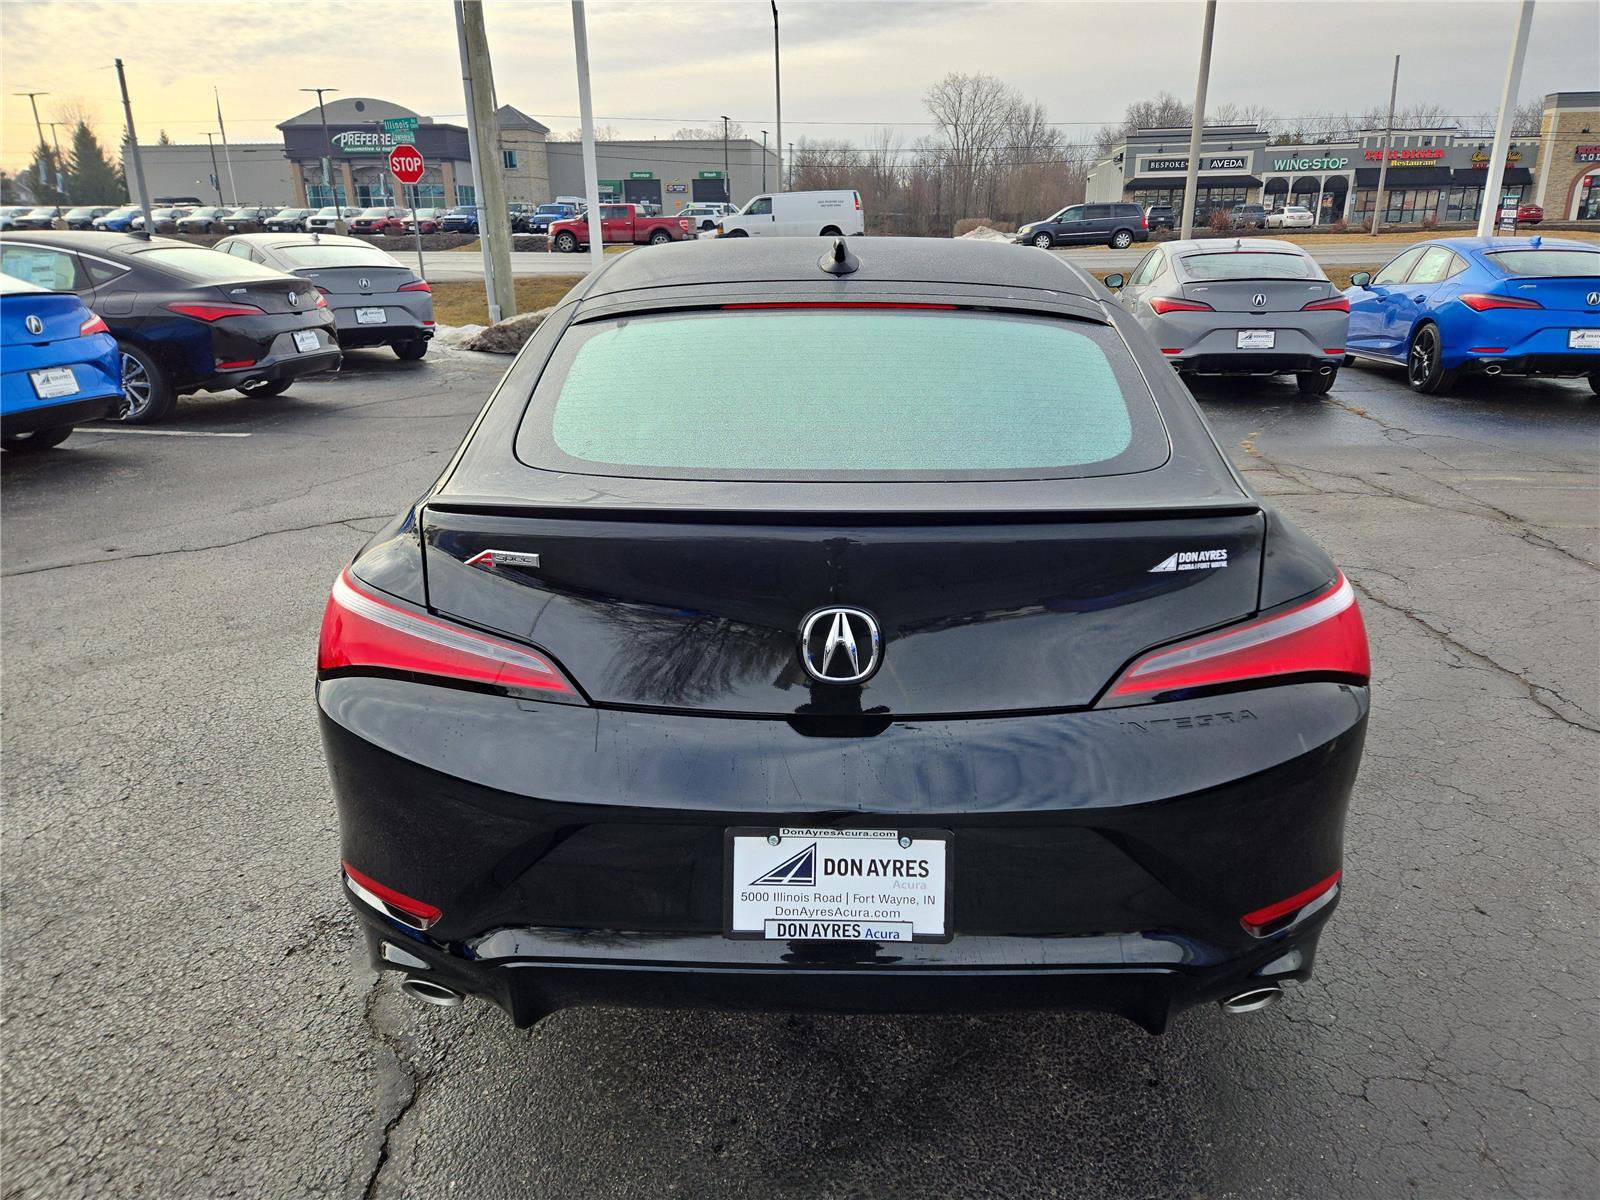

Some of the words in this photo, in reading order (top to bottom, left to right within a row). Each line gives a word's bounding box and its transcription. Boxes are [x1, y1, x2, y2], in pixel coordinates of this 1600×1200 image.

[384, 119, 409, 130] Illinois
[392, 157, 421, 172] STOP
[1150, 160, 1185, 169] BESPOKE
[1211, 159, 1243, 168] AVEDA
[1178, 551, 1198, 563] DON
[1198, 549, 1228, 561] AYRES
[1120, 709, 1258, 734] INTEGRA
[782, 828, 896, 838] DonAyresAcura.com
[824, 858, 863, 877] DON
[867, 858, 930, 878] AYRES
[892, 879, 927, 890] Acura
[741, 892, 769, 902] 5000
[773, 892, 810, 903] Illinois
[814, 893, 842, 903] Road
[853, 893, 875, 904] Fort
[878, 893, 919, 906] Wayne,
[923, 895, 936, 905] IN
[775, 906, 901, 918] DonAyresAcura.com
[777, 923, 810, 938] DON
[811, 923, 861, 938] AYRES
[864, 928, 900, 939] Acura
